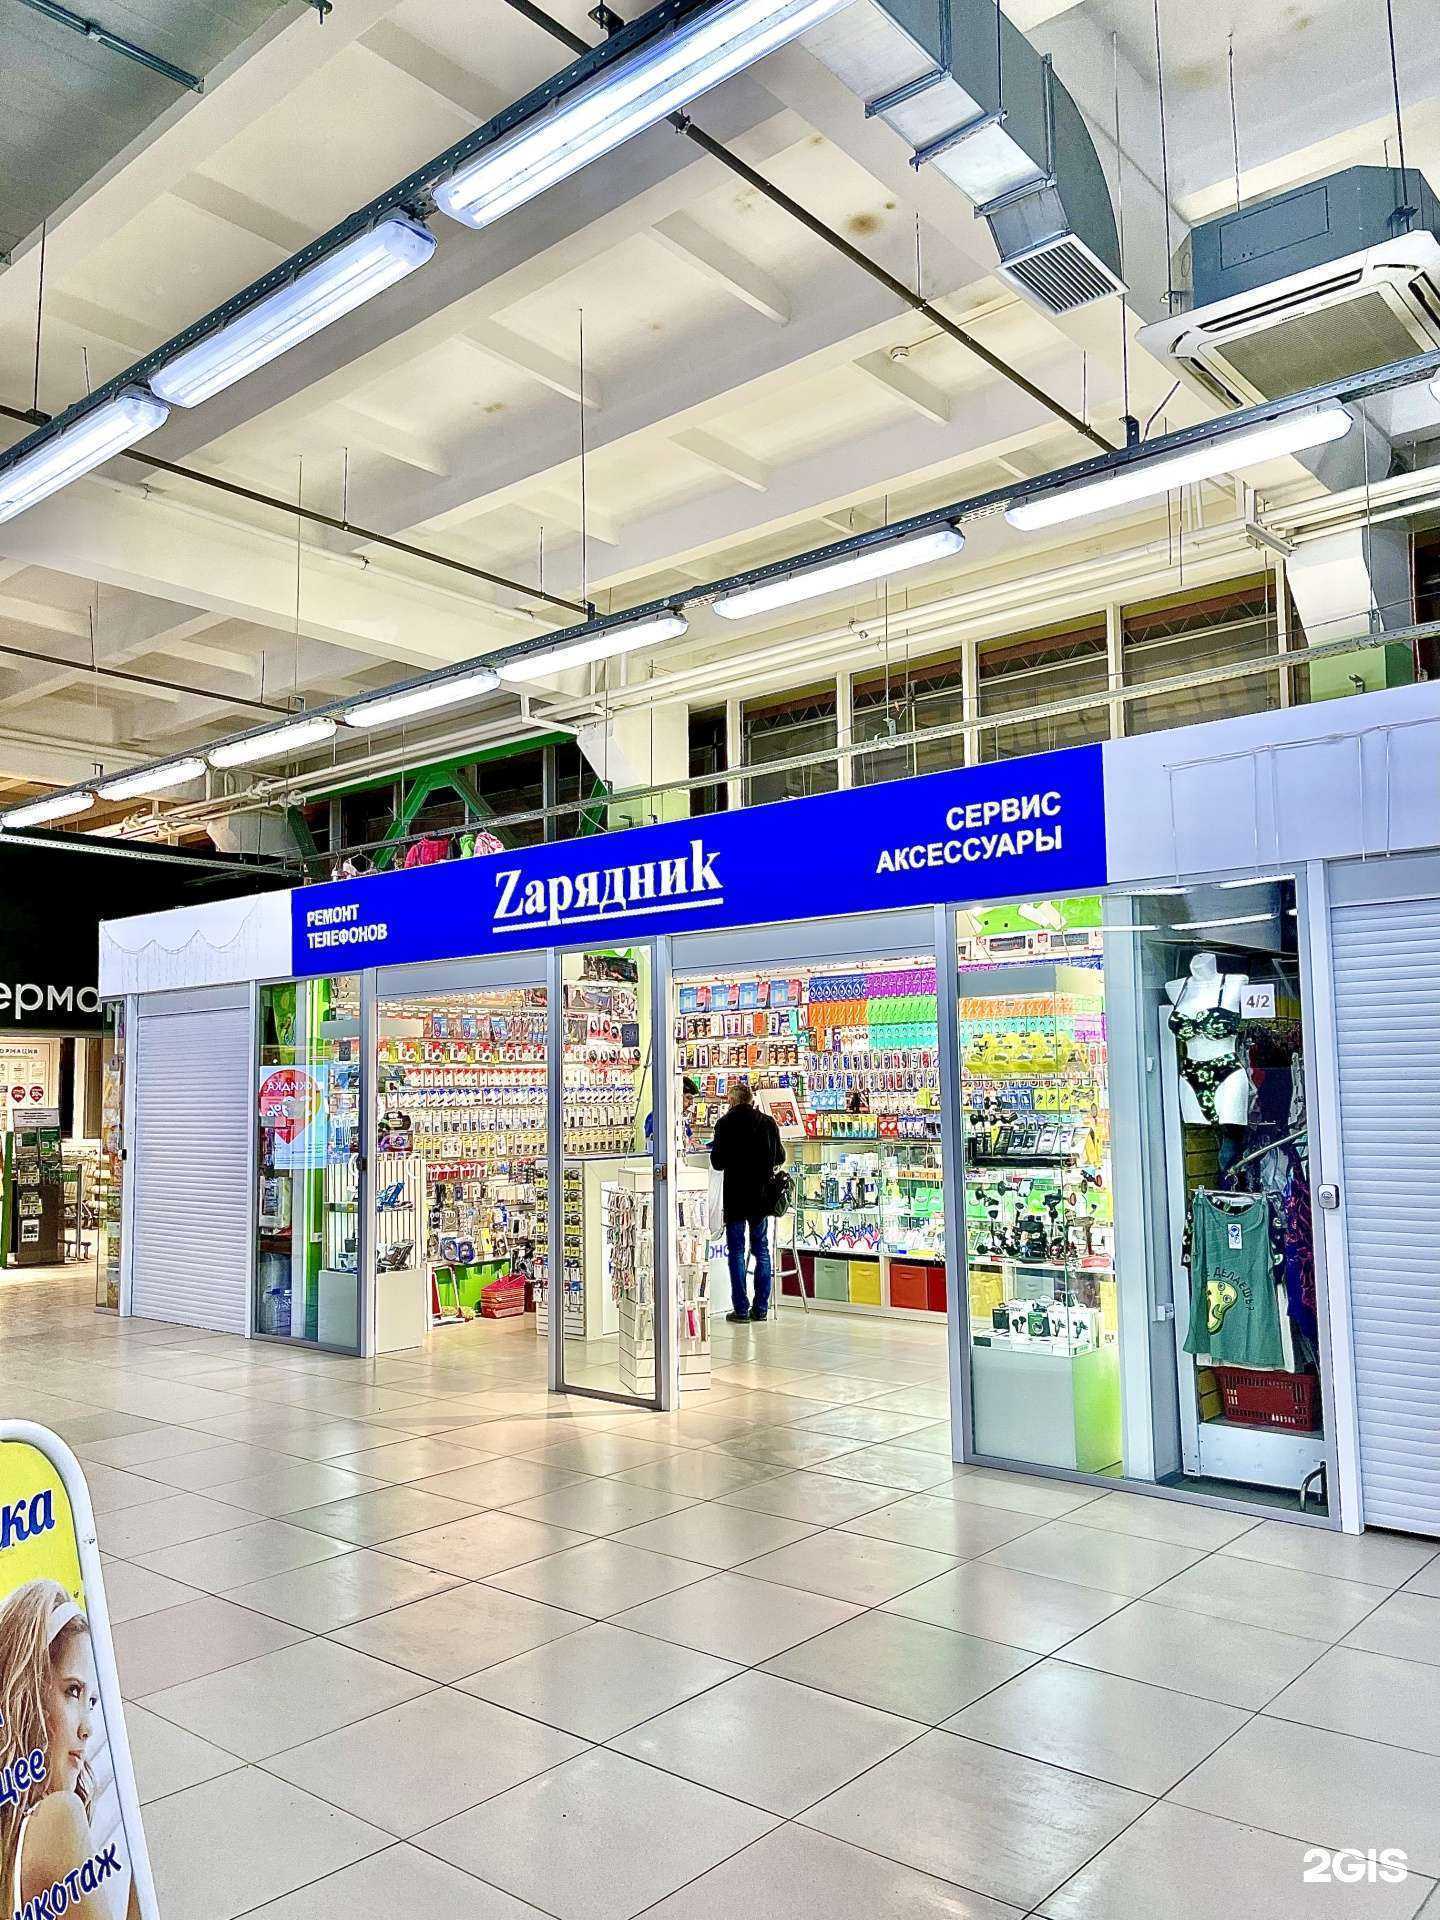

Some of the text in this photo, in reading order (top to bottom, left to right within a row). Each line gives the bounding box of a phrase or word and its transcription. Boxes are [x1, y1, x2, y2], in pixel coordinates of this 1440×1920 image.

[946, 791, 1061, 831] СЕРВИС
[876, 825, 1062, 874] АКСЕССУАРЫ
[306, 903, 360, 927] РЕМОНТ
[306, 923, 388, 949] ТЕЛЕФОНОВ
[1246, 994, 1270, 1009] 4/2
[0, 1489, 56, 1551] ка
